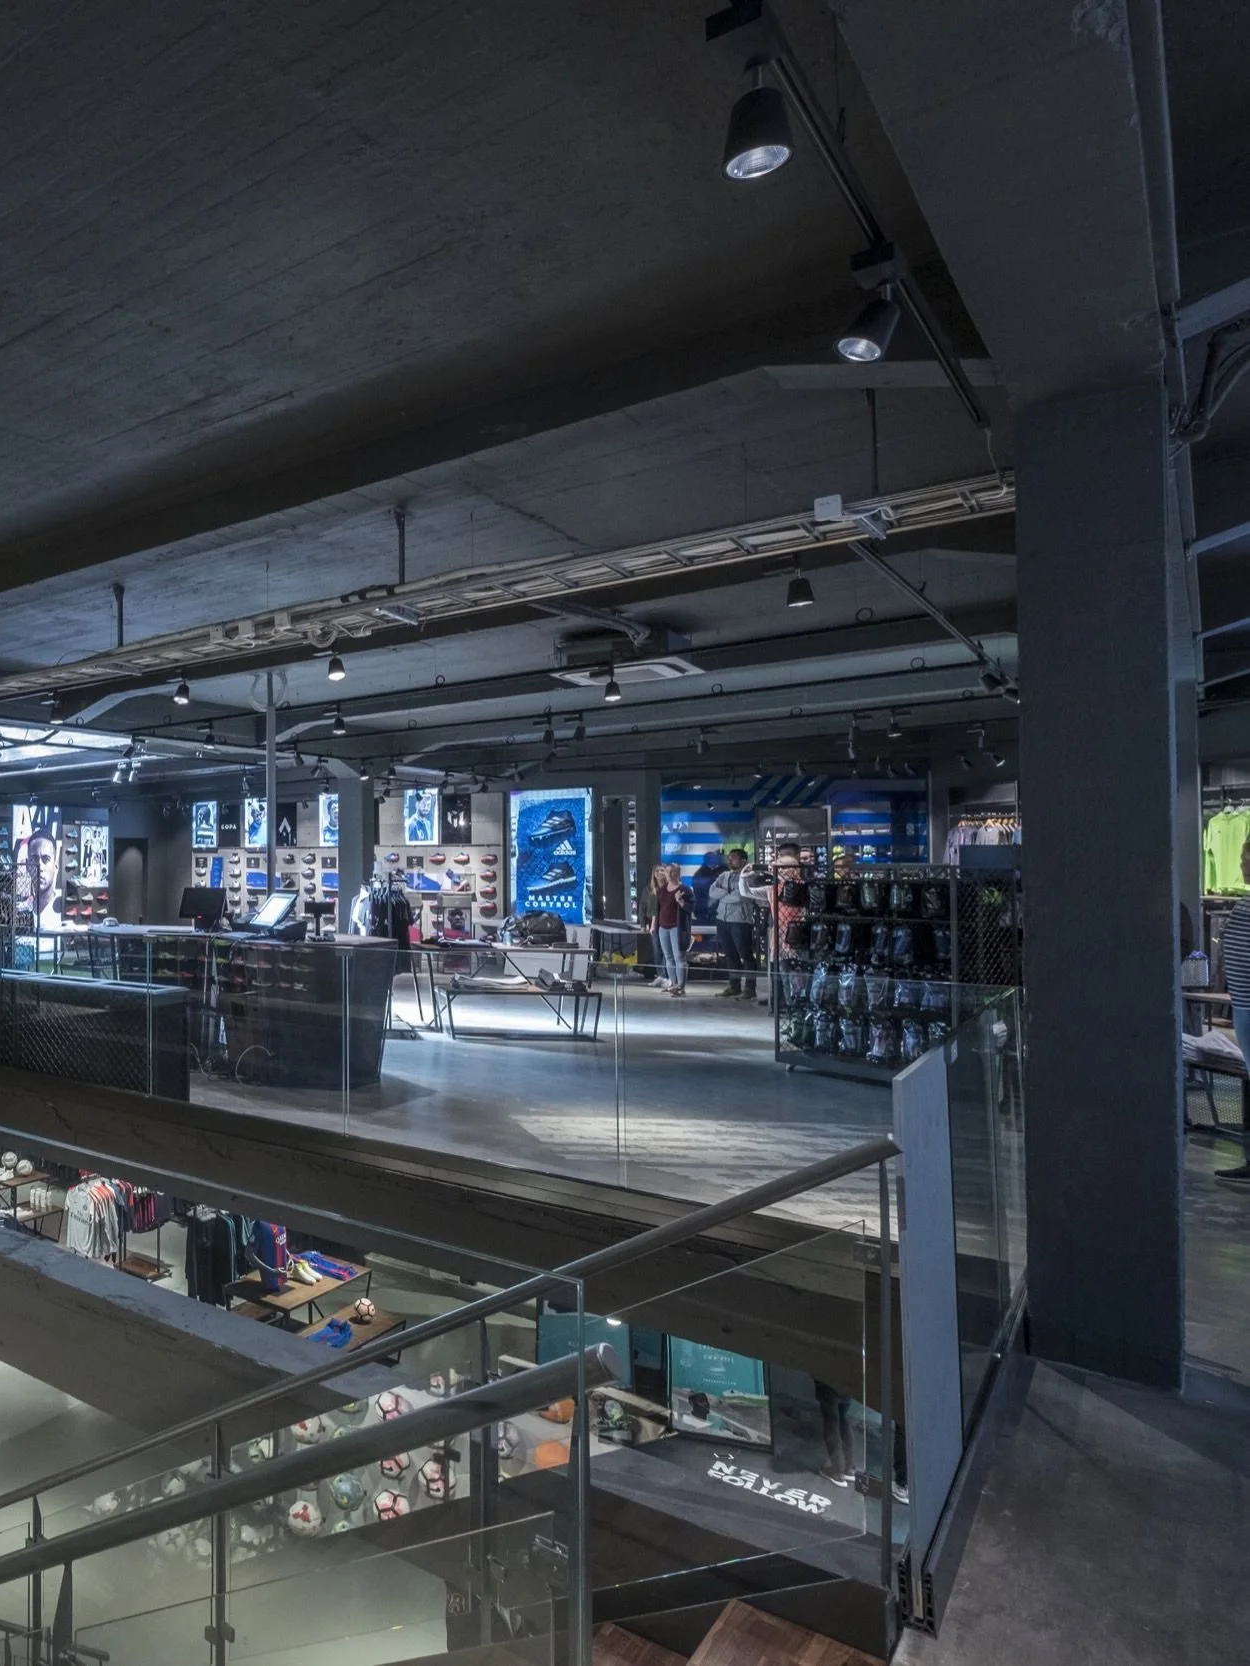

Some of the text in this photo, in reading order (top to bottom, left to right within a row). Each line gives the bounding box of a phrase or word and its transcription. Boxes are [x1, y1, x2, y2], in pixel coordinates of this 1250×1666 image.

[553, 849, 577, 857] adidas
[524, 901, 577, 909] CONTROL
[707, 1468, 827, 1515] FOLLOW
[712, 1460, 833, 1508] NEVER
